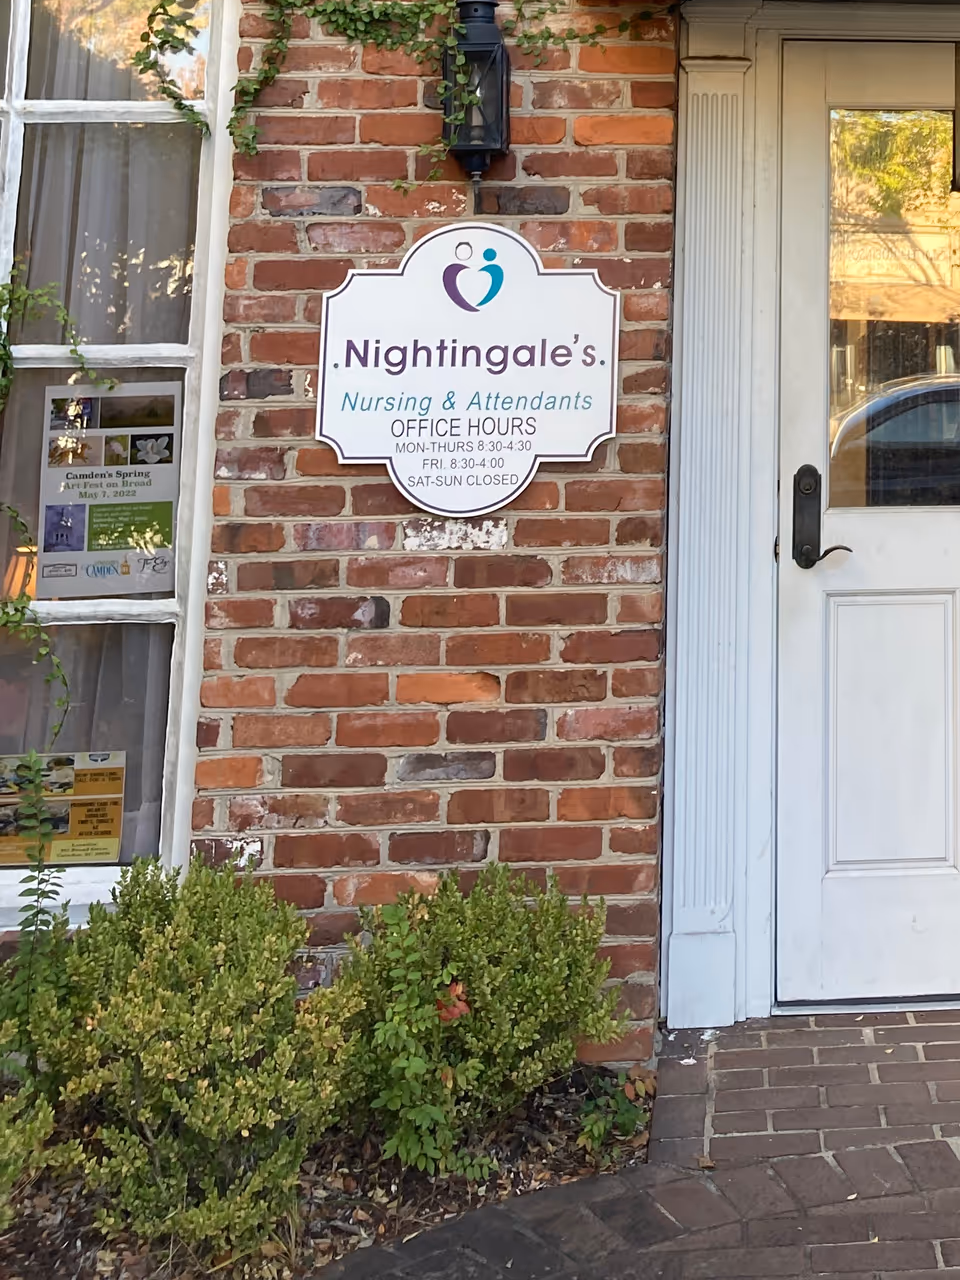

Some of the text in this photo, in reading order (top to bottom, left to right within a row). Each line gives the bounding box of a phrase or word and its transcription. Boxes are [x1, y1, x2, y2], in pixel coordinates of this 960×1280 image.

[345, 333, 596, 376] Nightingale's
[341, 390, 592, 416] Nursing & Attendants
[391, 416, 536, 437] OFFICE HOURS
[395, 439, 532, 453] MON-THURS 8:30-4:30
[422, 457, 505, 470] FRI. 8:30-4:00
[65, 469, 151, 480] Camden's Spring
[407, 473, 519, 488] SAT-SUN CLOSED
[64, 481, 80, 490] Art
[83, 480, 103, 489] Fest
[122, 479, 152, 487] Broad
[78, 491, 99, 500] May
[113, 489, 137, 498] 2022
